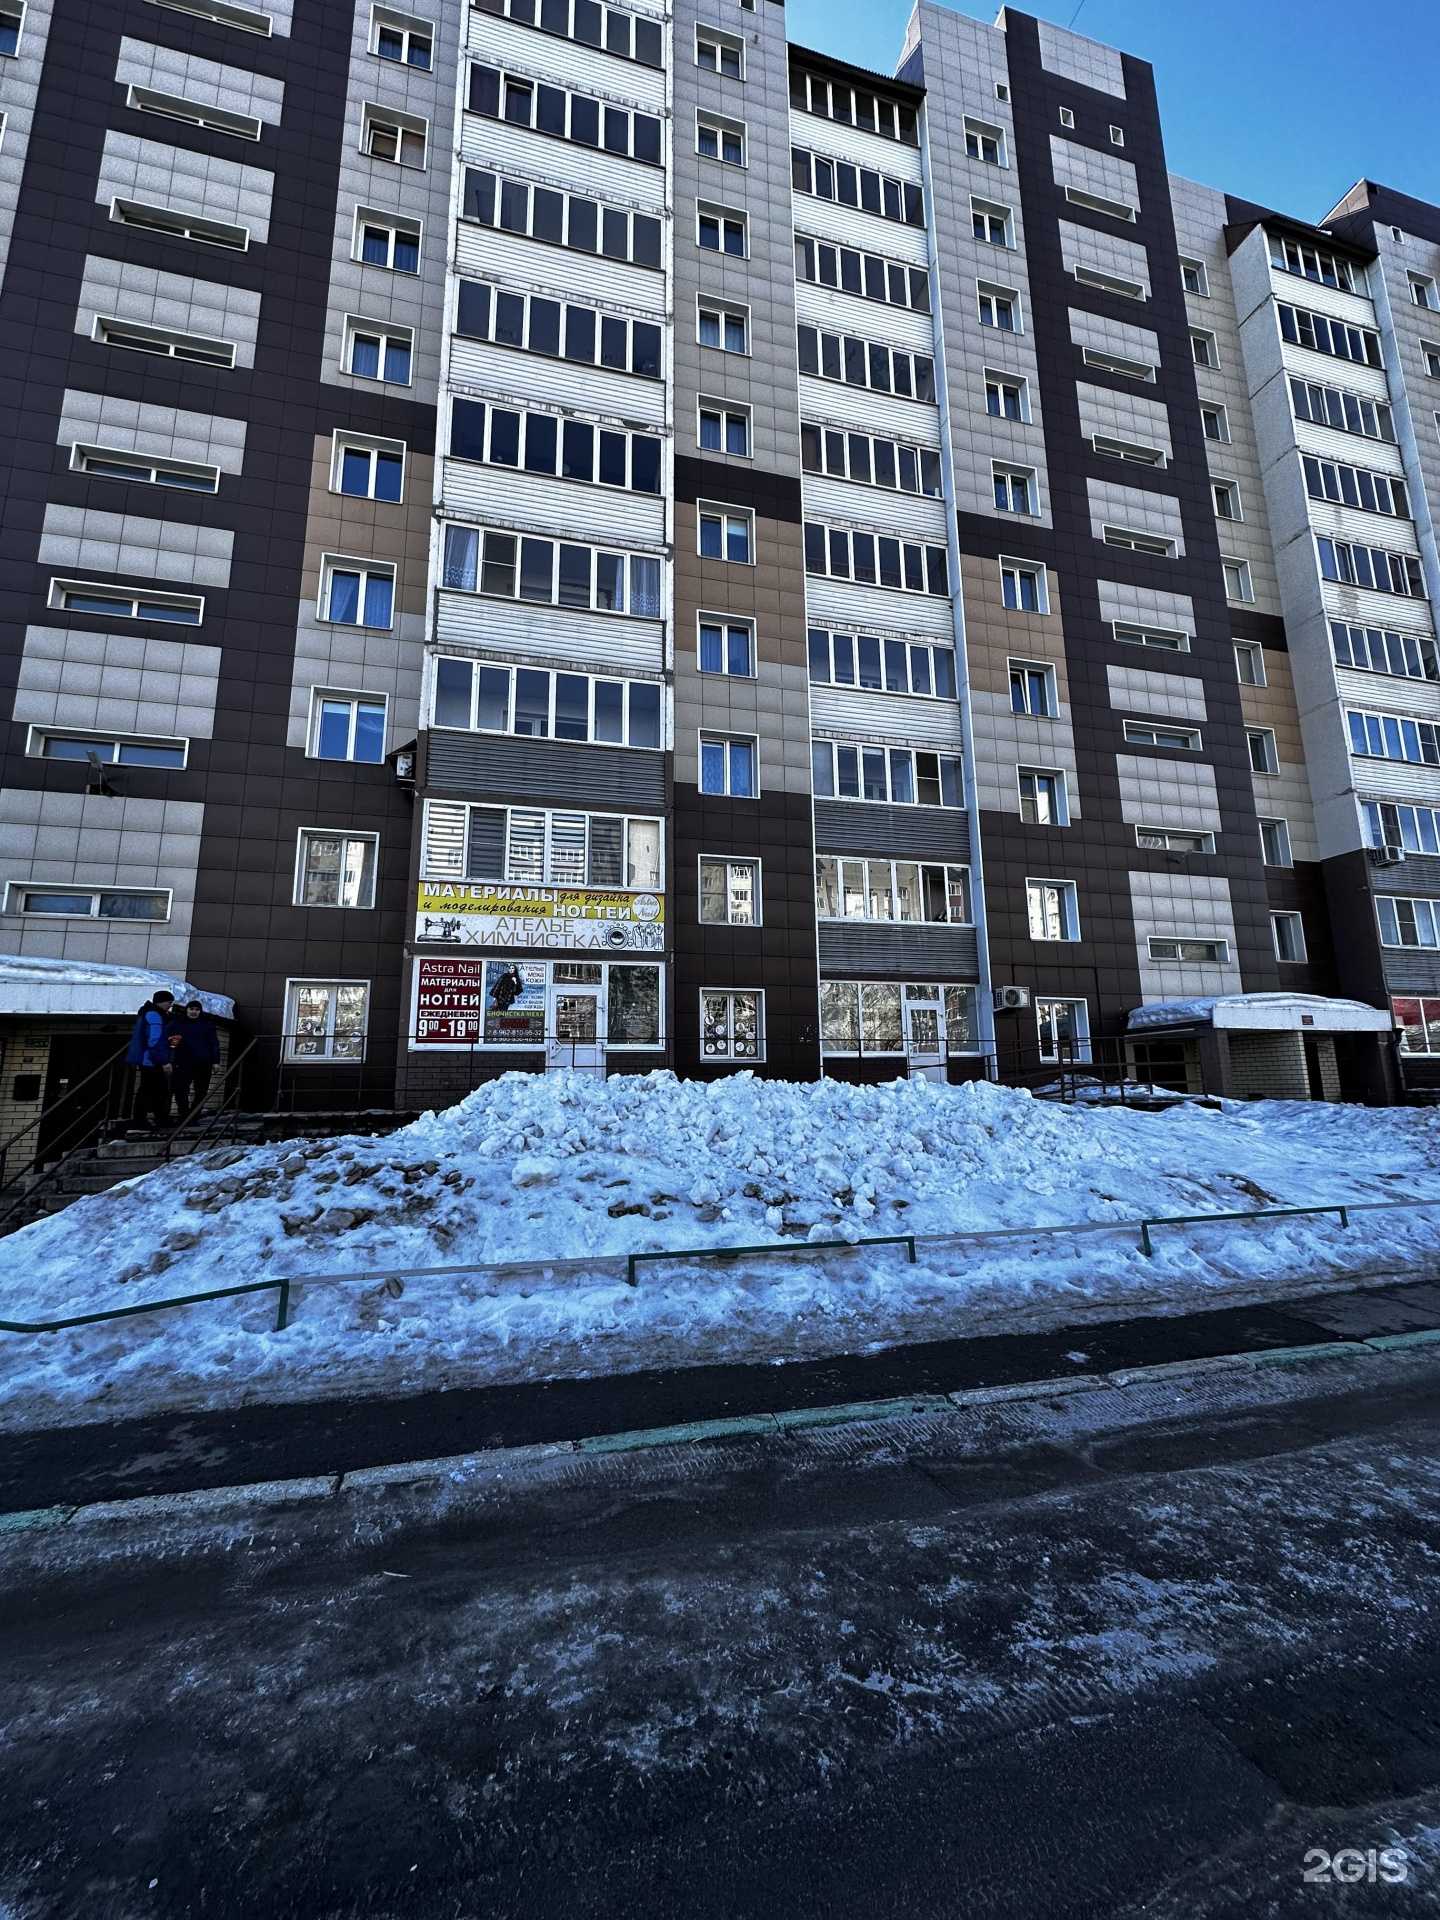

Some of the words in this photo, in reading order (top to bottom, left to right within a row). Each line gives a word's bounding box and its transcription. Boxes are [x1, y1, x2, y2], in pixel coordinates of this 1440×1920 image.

[424, 882, 558, 902] МАТЕРИАЛЫ
[559, 891, 580, 904] для
[585, 892, 630, 906] дизайна
[423, 901, 433, 909] и
[440, 900, 547, 914] моделирования
[553, 904, 631, 920] НОГТЕЙ
[496, 917, 574, 933] АТЕЛЬЕ
[466, 930, 601, 948] ХИМЧИСТКА
[422, 962, 454, 973] Astra
[458, 964, 480, 974] Nail
[421, 978, 480, 987] МАТЕРИАЛЫ
[420, 993, 479, 1006] НОГТЕЙ
